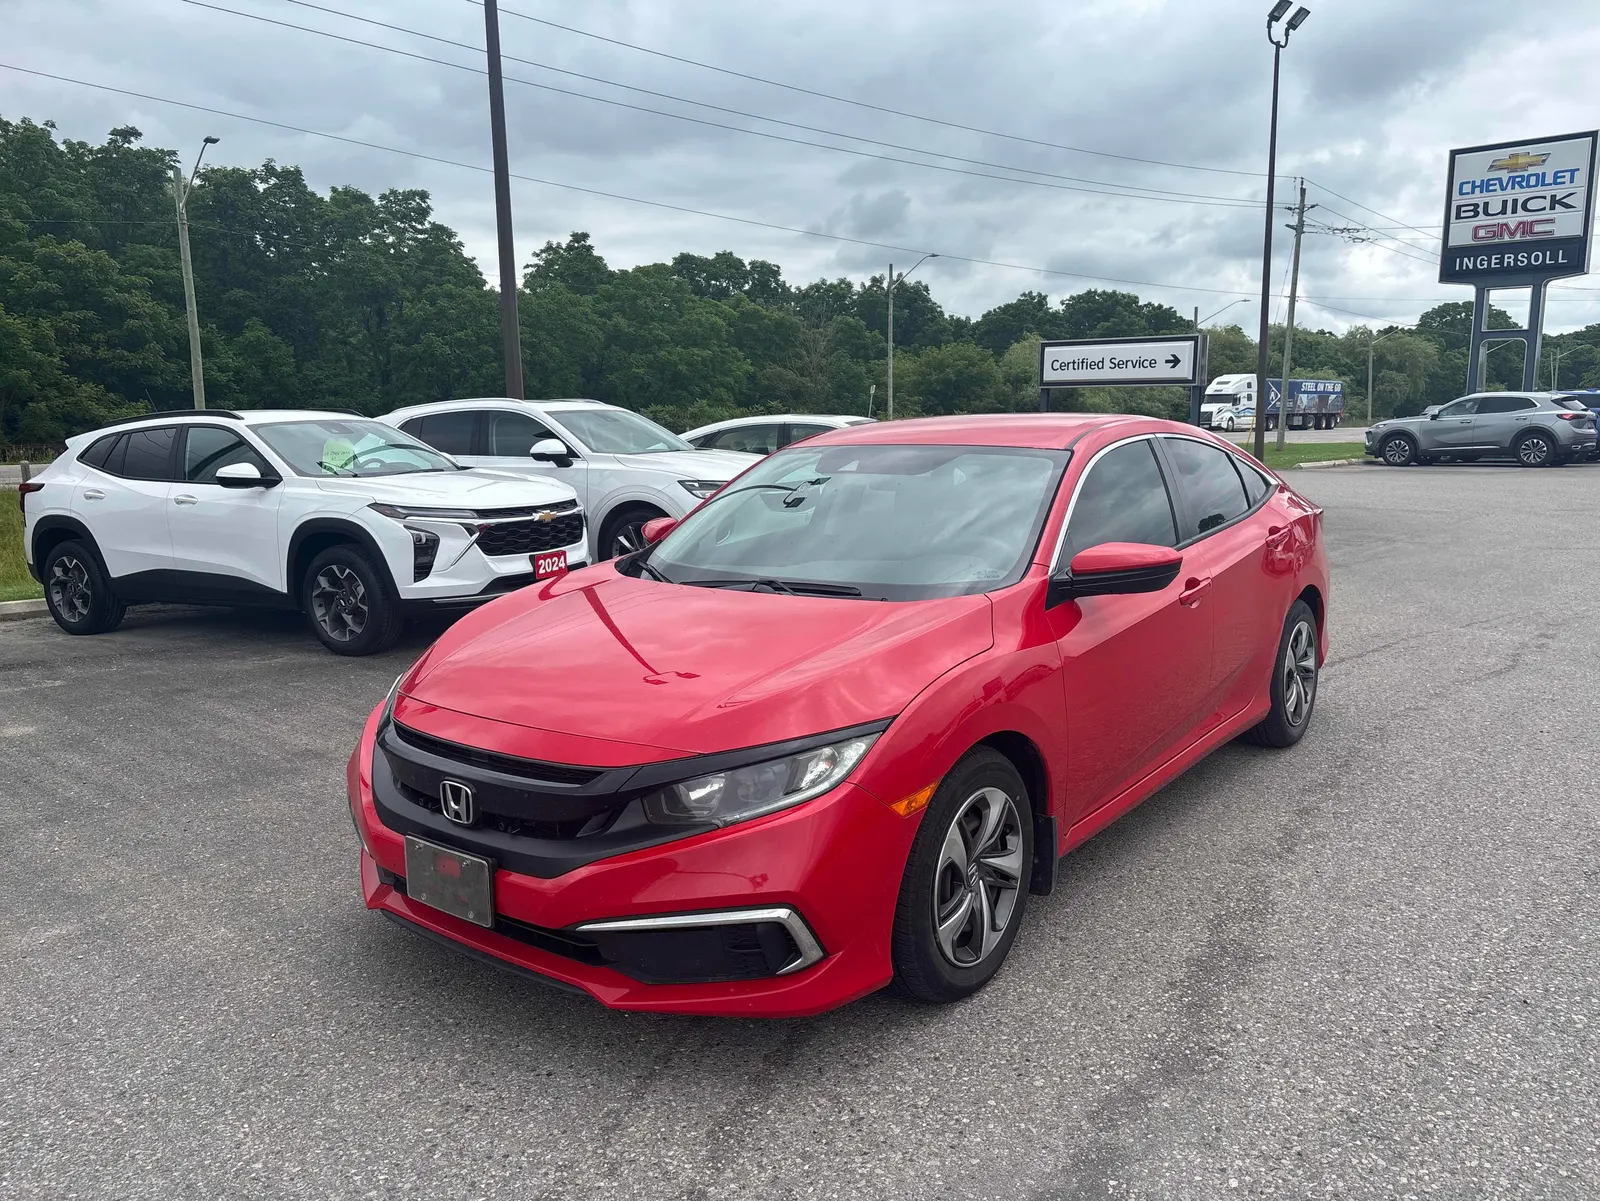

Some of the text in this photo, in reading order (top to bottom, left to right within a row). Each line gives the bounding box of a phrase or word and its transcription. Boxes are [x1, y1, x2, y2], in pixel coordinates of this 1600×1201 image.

[1458, 168, 1580, 196] CHEVROLET
[1455, 192, 1577, 220] BUICK
[1472, 217, 1555, 242] GMC
[1455, 250, 1568, 271] INGERSOLL
[1051, 356, 1157, 372] Certified Service
[1301, 382, 1316, 391] STEEL
[1317, 382, 1324, 392] ON
[1325, 383, 1334, 392] THE
[538, 555, 566, 574] 2024
